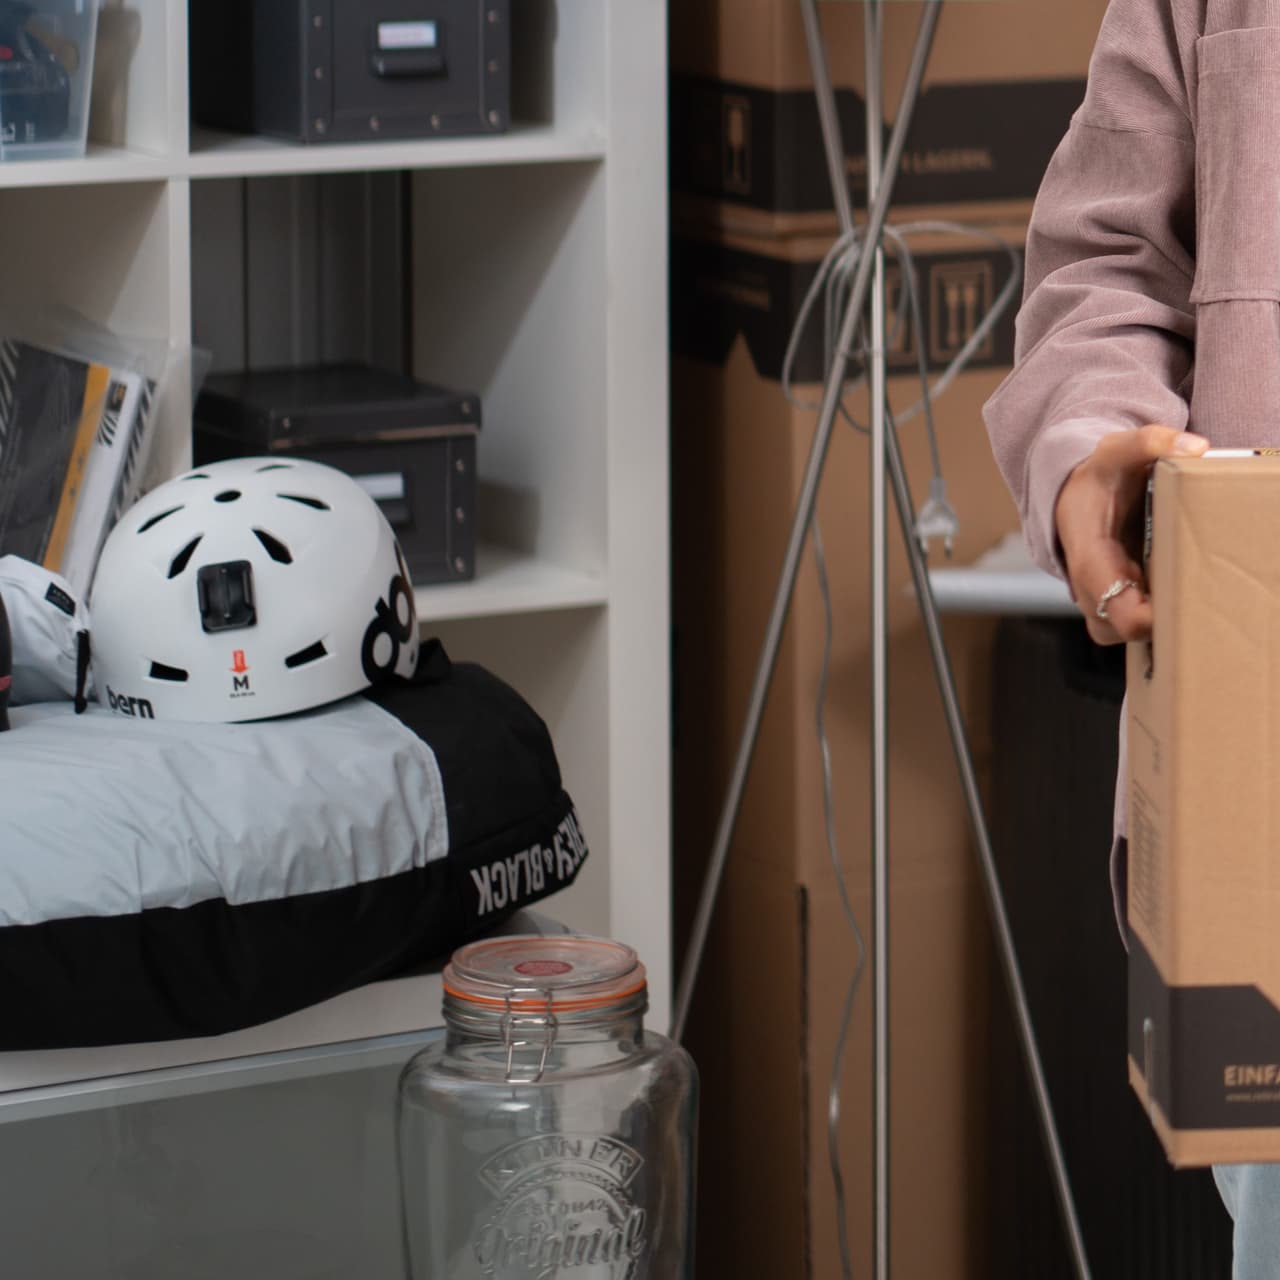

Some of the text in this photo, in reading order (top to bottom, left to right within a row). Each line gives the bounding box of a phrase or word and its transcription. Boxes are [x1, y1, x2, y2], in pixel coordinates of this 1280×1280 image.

[232, 674, 249, 691] M
[106, 684, 155, 719] bern
[470, 843, 545, 917] BLACK
